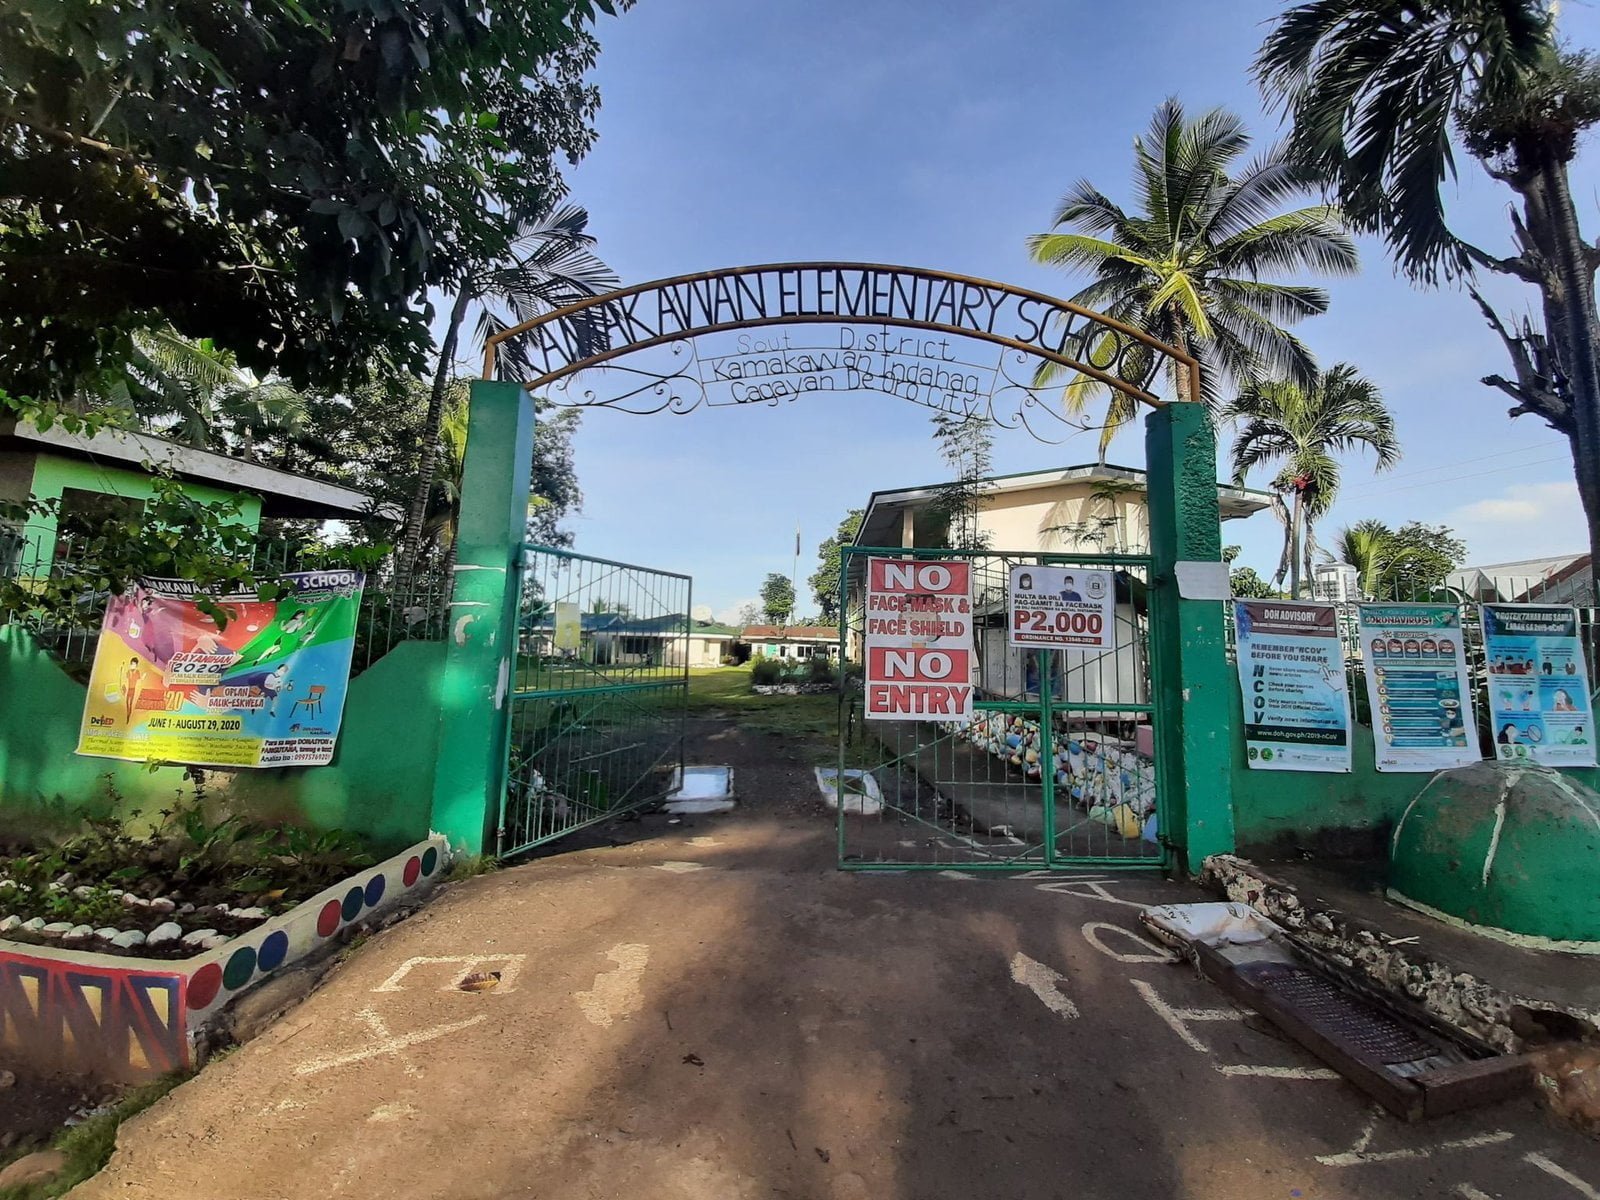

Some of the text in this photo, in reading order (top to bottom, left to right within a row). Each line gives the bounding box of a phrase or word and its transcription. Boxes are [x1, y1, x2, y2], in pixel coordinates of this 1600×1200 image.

[778, 269, 1010, 334] ELEMENTARY
[1015, 297, 1165, 400] SCHOOL
[840, 324, 956, 362] District
[711, 350, 872, 382] Kamakawan
[730, 377, 834, 407] Cagayan
[846, 368, 874, 390] De
[926, 385, 980, 425] City
[302, 574, 357, 590] SCHOOL
[884, 563, 952, 591] NO
[869, 595, 970, 614] FACE MASK &
[1014, 610, 1103, 635] P2,000
[1264, 609, 1317, 622] DOH ADVISORY
[869, 619, 965, 637] FACE SHIELD
[1251, 643, 1295, 653] REMEMBER
[884, 650, 953, 679] NO
[1251, 651, 1328, 663] BEFORE YOU SHARE
[173, 663, 219, 673] 2020
[1253, 664, 1265, 677] N
[225, 688, 248, 696] OPLAN
[1253, 680, 1265, 693] C
[869, 684, 970, 714] ENTRY
[1253, 696, 1265, 709] O
[148, 717, 166, 728] JUNE
[168, 719, 172, 728] 1
[176, 719, 206, 730] AUGUST
[207, 720, 219, 732] 29,
[221, 720, 241, 730] 2020
[1253, 711, 1265, 724] V
[1257, 730, 1338, 740] www.doh.gov.ph/2019-nCoV
